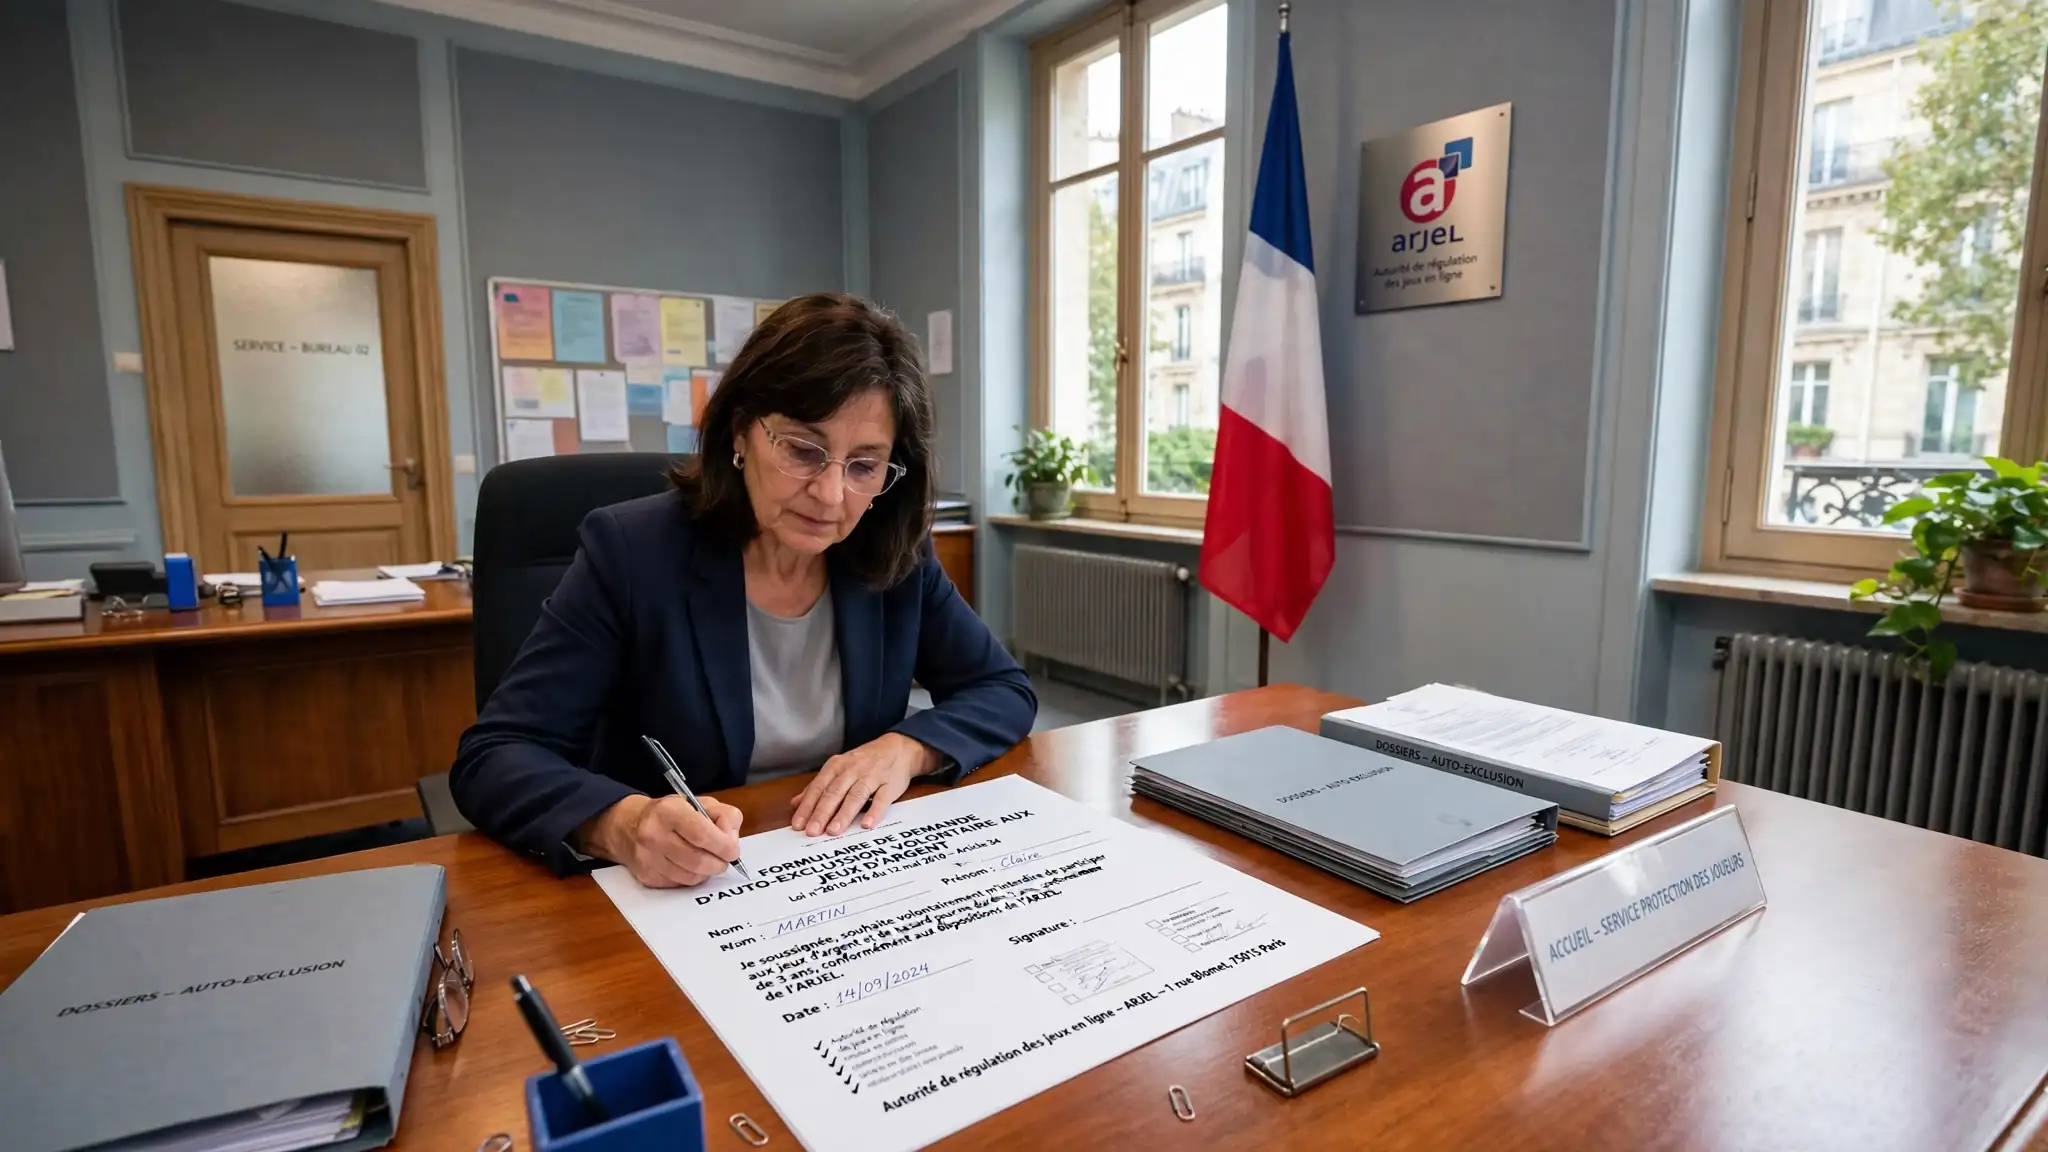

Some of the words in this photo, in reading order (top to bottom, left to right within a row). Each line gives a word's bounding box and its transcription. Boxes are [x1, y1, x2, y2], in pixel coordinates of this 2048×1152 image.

[1374, 263, 1410, 277] Autorité
[1412, 262, 1424, 272] de
[1427, 254, 1478, 270] régulation
[1384, 279, 1400, 289] des
[1401, 277, 1421, 290] jeux
[1424, 274, 1436, 283] en
[1439, 271, 1463, 284] ligne
[233, 339, 285, 353] SERVICE
[301, 342, 353, 354] BUREAU
[355, 343, 369, 356] 02
[1376, 739, 1421, 760] DOSSIERS
[1431, 754, 1525, 789] AUTO-EXCLUSION
[758, 842, 871, 877] FORMULAIRE
[873, 834, 897, 845] DE
[900, 813, 981, 839] DEMANDE
[891, 819, 999, 850] VOLONTAIRE
[1000, 810, 1035, 824] AUX
[818, 866, 862, 885] JEUX
[863, 841, 949, 870] D'ARGENT
[1001, 851, 1042, 868] Claire
[789, 892, 807, 902] Loi
[872, 871, 887, 879] du
[888, 866, 902, 874] 12
[941, 868, 988, 886] Prénom
[740, 958, 756, 971] Je
[841, 916, 895, 940] souhaite
[1045, 867, 1059, 876] de
[777, 904, 846, 934] MARTIN
[1549, 926, 1594, 962] ACCUEIL
[1600, 907, 1641, 936] SERVICE
[1640, 877, 1695, 918] PROTECTION
[1694, 869, 1710, 889] DES
[1709, 852, 1745, 884] JOUEURS
[708, 923, 744, 939] Nom
[1008, 920, 1070, 945] Signature
[748, 967, 775, 981] aux
[777, 956, 808, 974] jeux
[810, 938, 863, 961] d'argent
[56, 990, 160, 1018] DOSSIERS
[179, 959, 346, 995] AUTO-EXCLUSION
[755, 980, 775, 991] de
[776, 974, 787, 984] 3
[790, 965, 820, 980] ans,
[765, 990, 784, 1002] de
[787, 971, 844, 995] l'ARJEL.
[836, 962, 929, 1004] 14/09/2024
[782, 1005, 821, 1023] Date
[882, 1080, 939, 1112] Autorité
[940, 1075, 958, 1088] de
[958, 1048, 1023, 1080] régulation
[1021, 1038, 1045, 1053] des
[1042, 1027, 1072, 1045] jeux
[1071, 1021, 1087, 1033] en
[1083, 1008, 1116, 1026] ligne
[1123, 991, 1159, 1011] ARJEL
[1165, 983, 1175, 992] 1
[1174, 976, 1194, 989] rue
[1229, 948, 1262, 965] 75015
[1258, 938, 1286, 954] Paris
